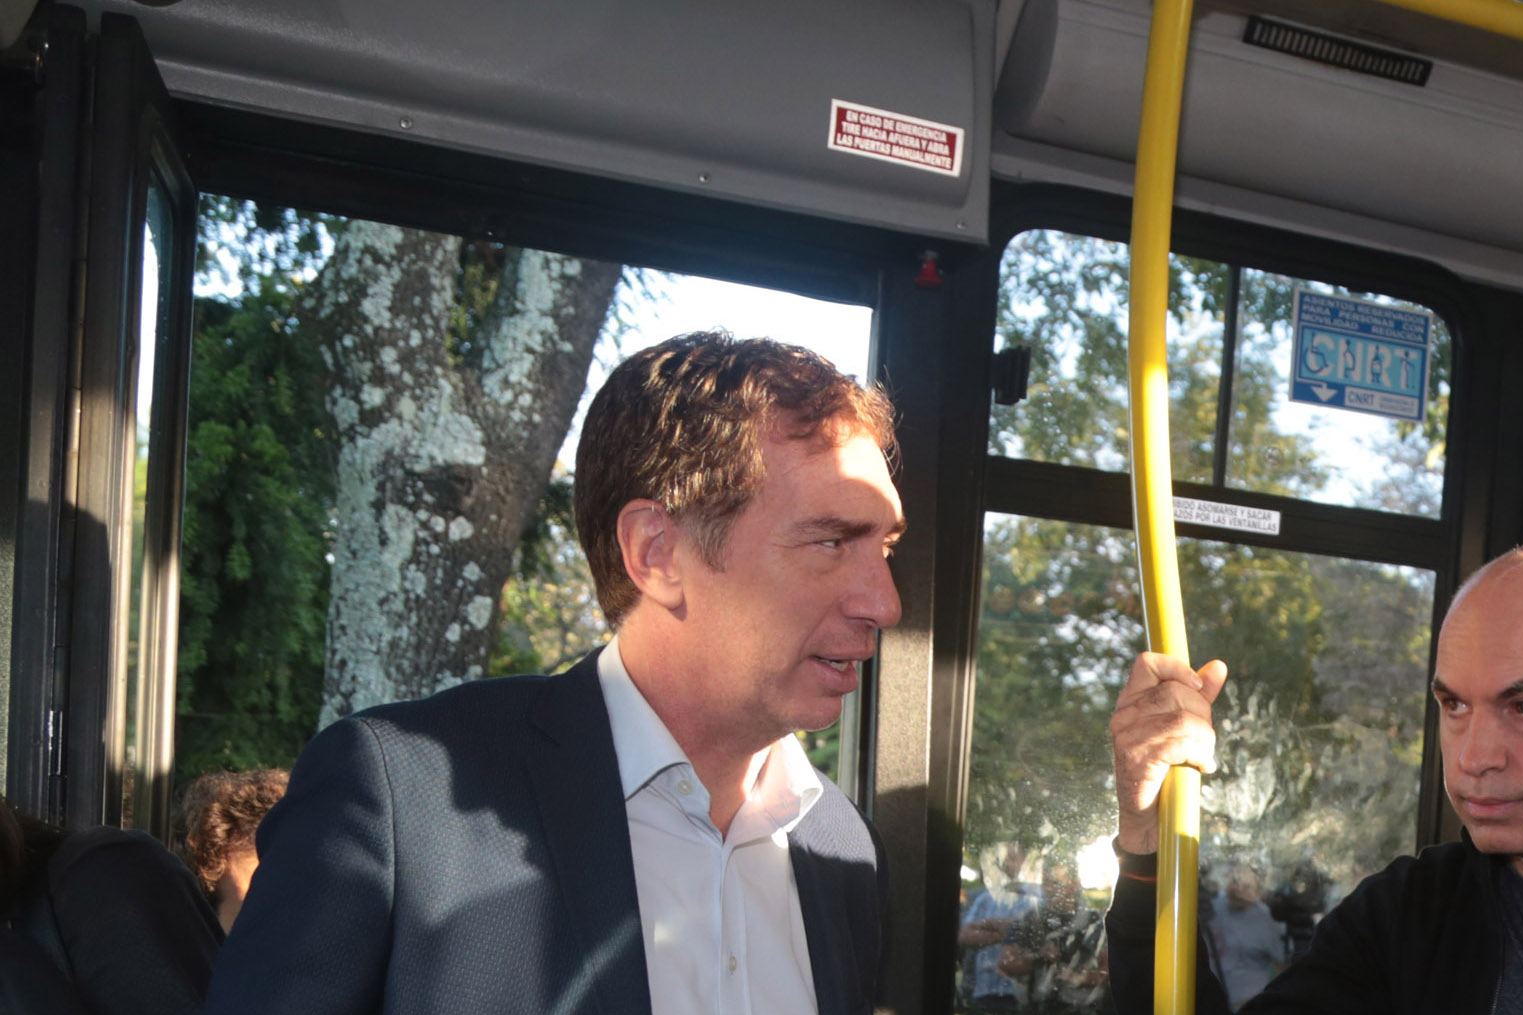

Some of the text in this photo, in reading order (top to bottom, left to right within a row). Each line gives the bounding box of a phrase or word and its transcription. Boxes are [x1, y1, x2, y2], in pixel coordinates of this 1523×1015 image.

[842, 121, 950, 156] TIRE HACIA AFUERA Y ABRA
[846, 110, 947, 143] EN CASO DE EMERGENCIA
[836, 133, 952, 169] LAS PUERTAS MANUALMENTE
[1302, 304, 1424, 332] PARA PERSONAS CON
[1303, 295, 1425, 325] ASIENTOS RESERVADOS
[1301, 313, 1424, 342] MOVILIDAD REDUCIDA
[1308, 333, 1418, 390] CNRT
[1348, 390, 1375, 406] CNRT
[1195, 512, 1210, 522] POR
[1212, 514, 1226, 525] LAS
[1228, 517, 1277, 532] VENTANILLAS
[1198, 502, 1238, 516] ASOMARSE
[1240, 508, 1245, 517] Y
[1247, 510, 1272, 520] SACAR
